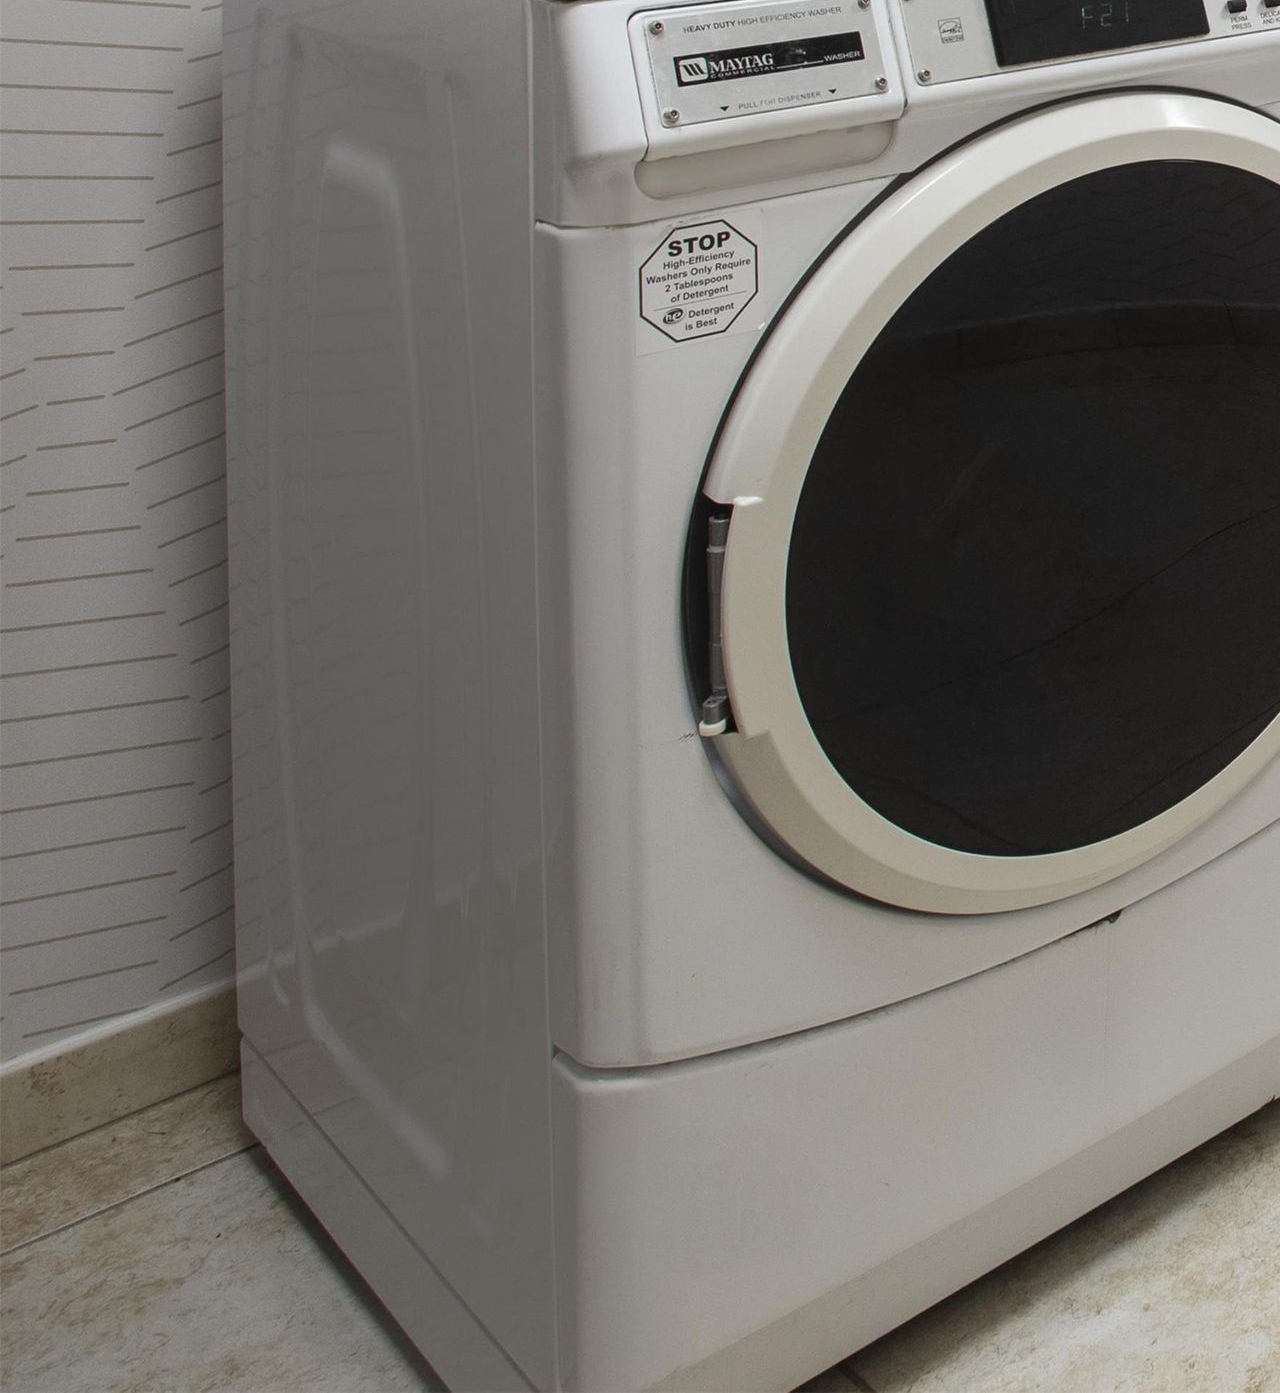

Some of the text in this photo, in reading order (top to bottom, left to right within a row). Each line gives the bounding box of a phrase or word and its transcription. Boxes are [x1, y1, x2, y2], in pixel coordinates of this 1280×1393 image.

[683, 6, 842, 34] HEAVY DUTY HIGH EFFICIENCY WASHER
[1230, 15, 1248, 23] PERM
[1232, 22, 1252, 31] PRESS
[709, 53, 774, 74] MAYTAG
[823, 50, 861, 62] WASHER
[710, 65, 776, 79] COMMERCIAL
[738, 100, 758, 109] PULL
[777, 91, 821, 104] DISPENSER
[667, 231, 731, 258] STOP
[662, 249, 735, 271] High-Efficiency
[646, 257, 752, 285] Washers Only Require
[664, 273, 734, 293] 2 Tablespoons
[670, 284, 729, 304] of Detergent
[688, 302, 735, 319] Detergent
[684, 317, 718, 331] is Best
